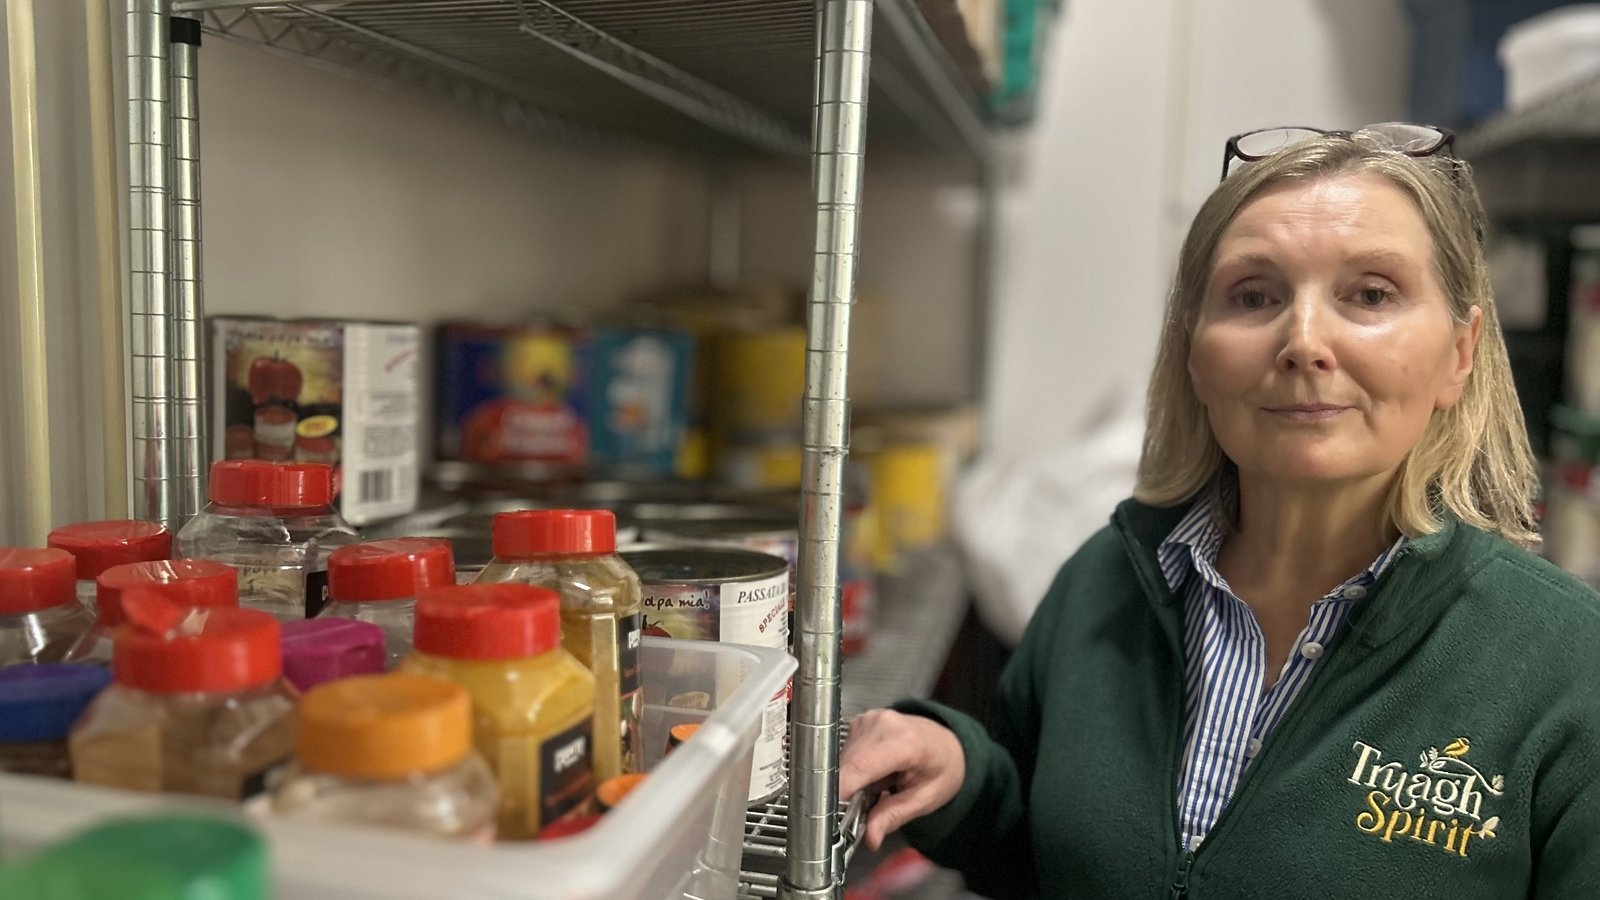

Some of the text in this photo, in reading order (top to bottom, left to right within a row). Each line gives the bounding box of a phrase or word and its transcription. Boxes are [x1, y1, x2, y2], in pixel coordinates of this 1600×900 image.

[642, 590, 710, 611] apa mia!
[737, 585, 780, 603] PASSATA
[1356, 789, 1474, 858] Spirit
